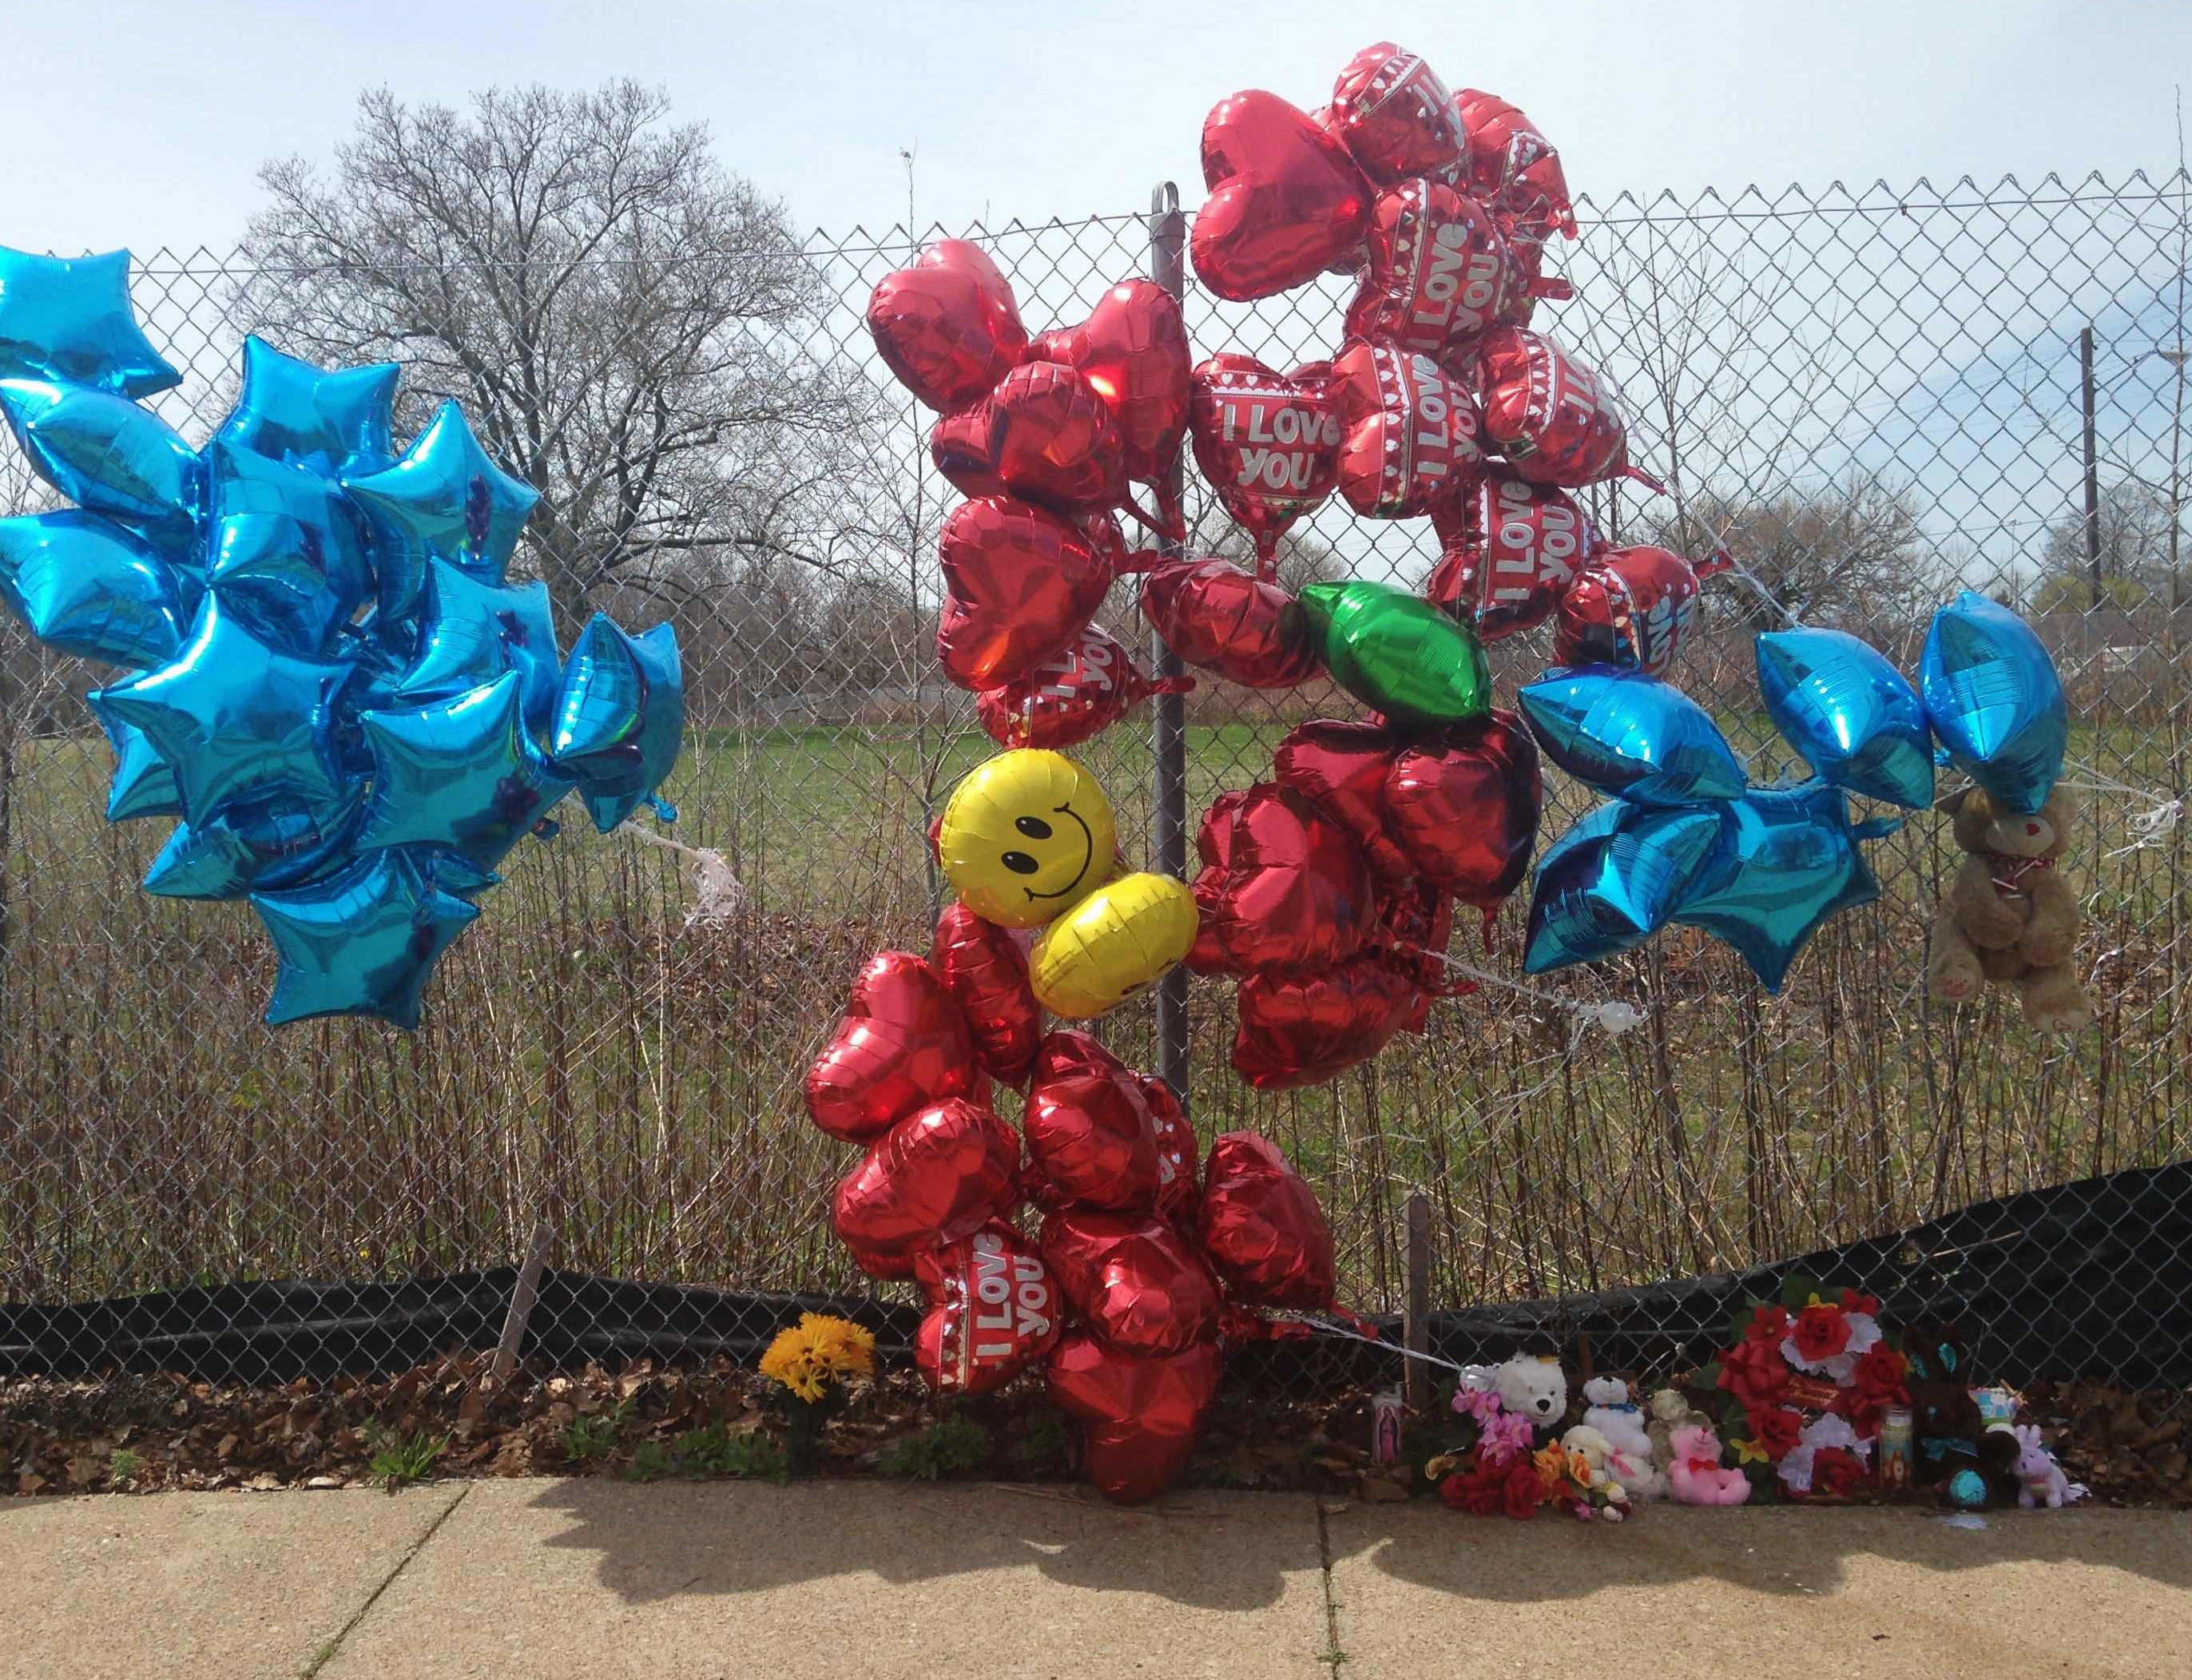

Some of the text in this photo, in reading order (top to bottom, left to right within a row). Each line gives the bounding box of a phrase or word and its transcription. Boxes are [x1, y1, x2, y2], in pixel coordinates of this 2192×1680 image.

[1407, 337, 1439, 350] I
[1223, 404, 1236, 441] I
[1416, 461, 1447, 475] I
[1495, 588, 1531, 600] I
[1013, 1255, 1050, 1337] YOU
[976, 1343, 1011, 1356] I
